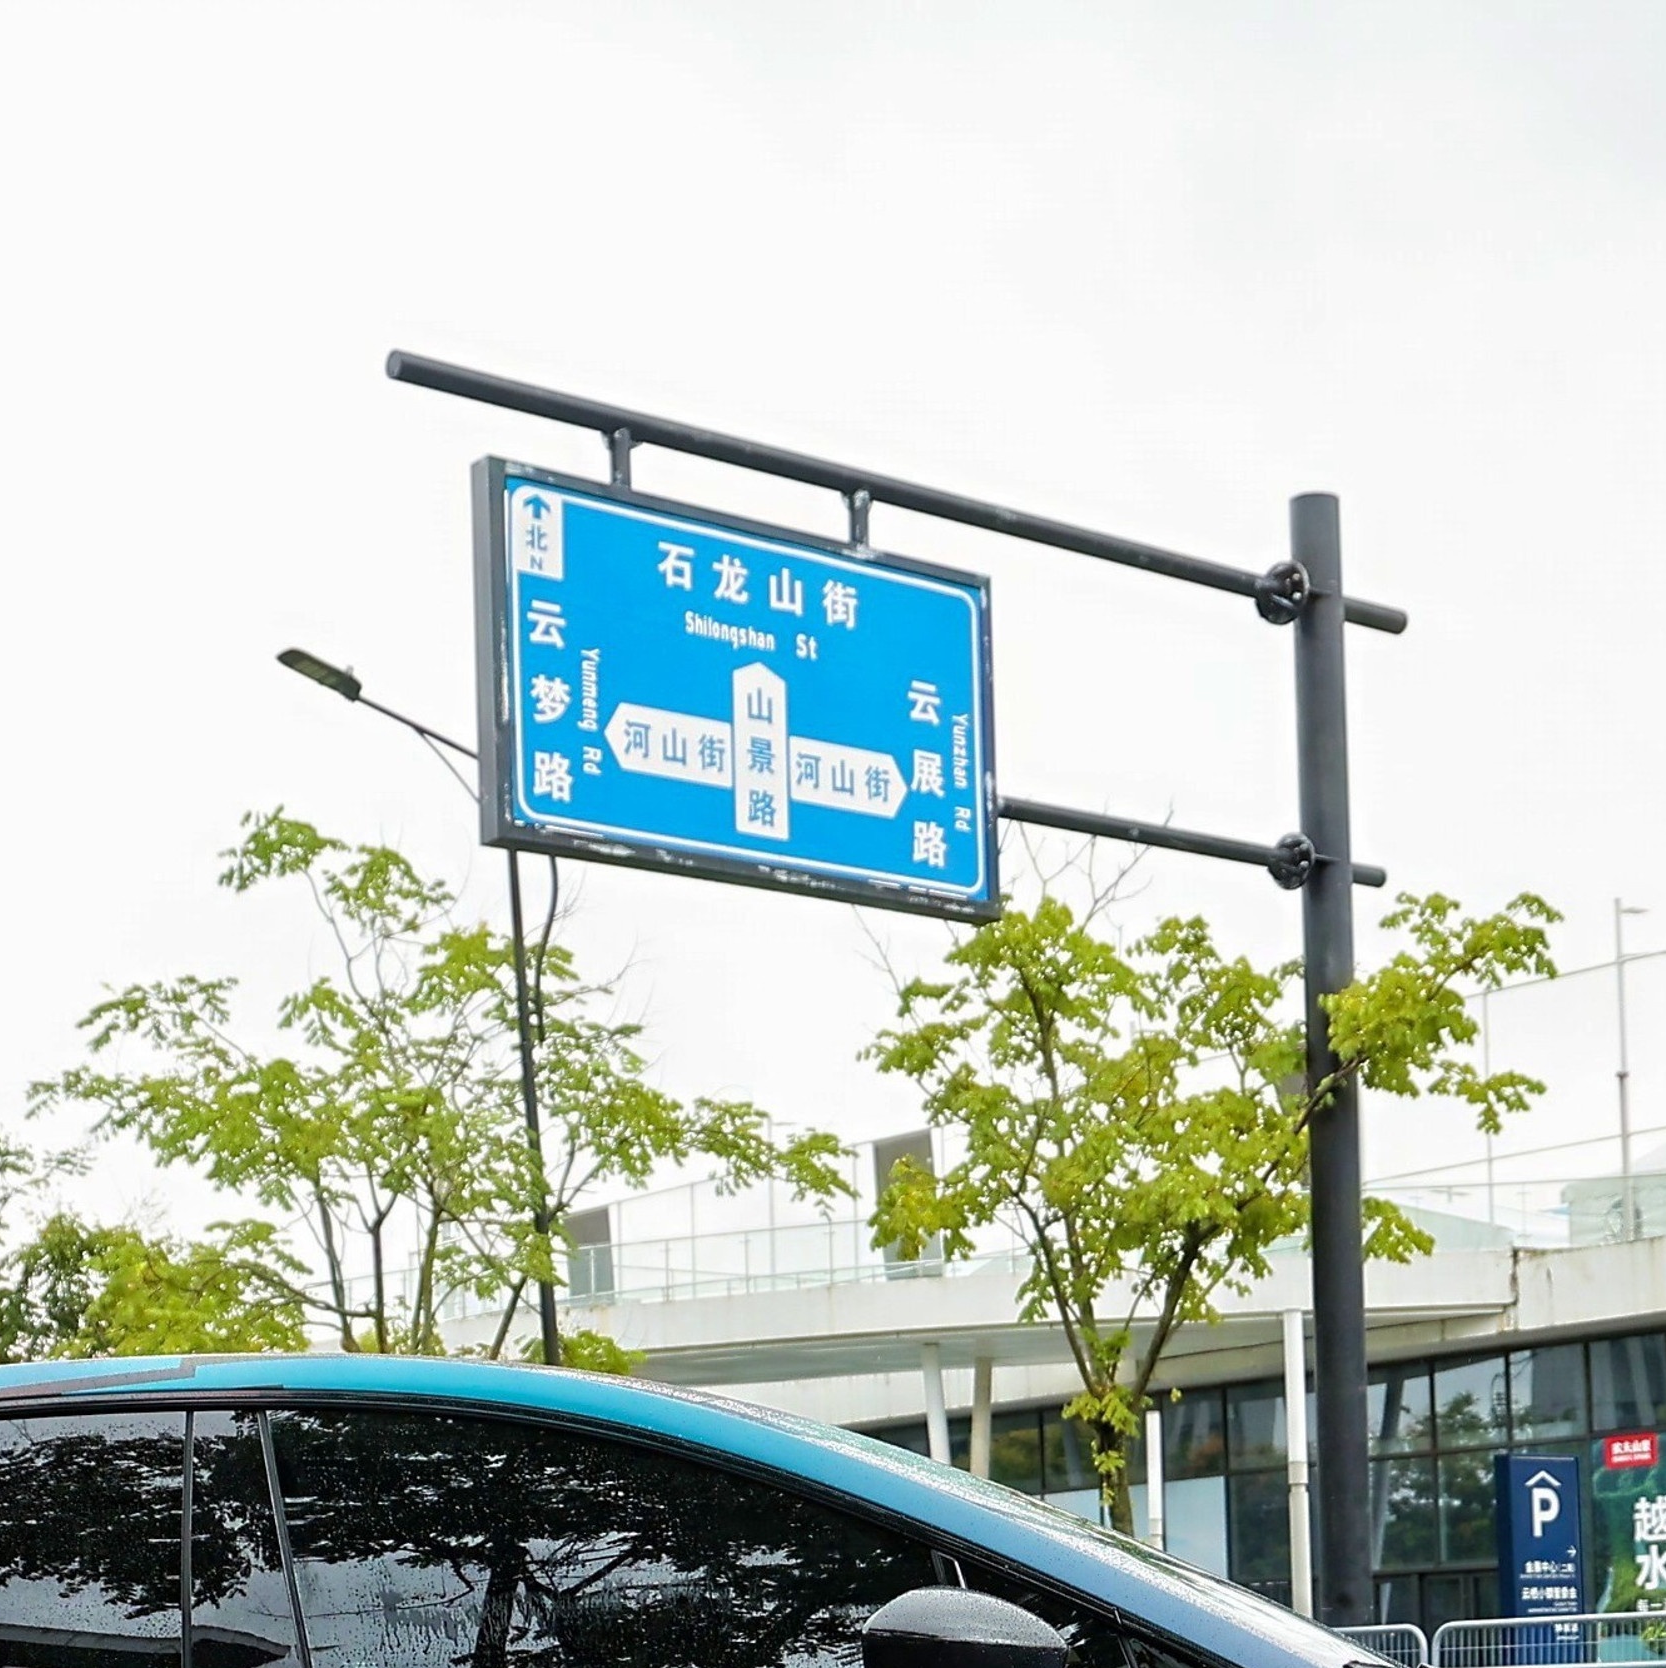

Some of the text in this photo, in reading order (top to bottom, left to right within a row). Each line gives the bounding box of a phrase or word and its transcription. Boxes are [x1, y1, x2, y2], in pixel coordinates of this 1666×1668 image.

[525, 525, 547, 550] 北
[530, 556, 544, 571] N
[657, 540, 858, 630] 石龙山街
[684, 610, 818, 660] Shilongshan St
[527, 598, 574, 803] 云梦路
[577, 647, 603, 776] Yunmeng Rd
[623, 718, 726, 773] 河山街
[746, 686, 777, 828] 山景路
[795, 751, 891, 803] 河山街
[907, 679, 948, 869] 云展路
[951, 713, 972, 833] Yunzhan Rd
[1531, 1486, 1561, 1538] P
